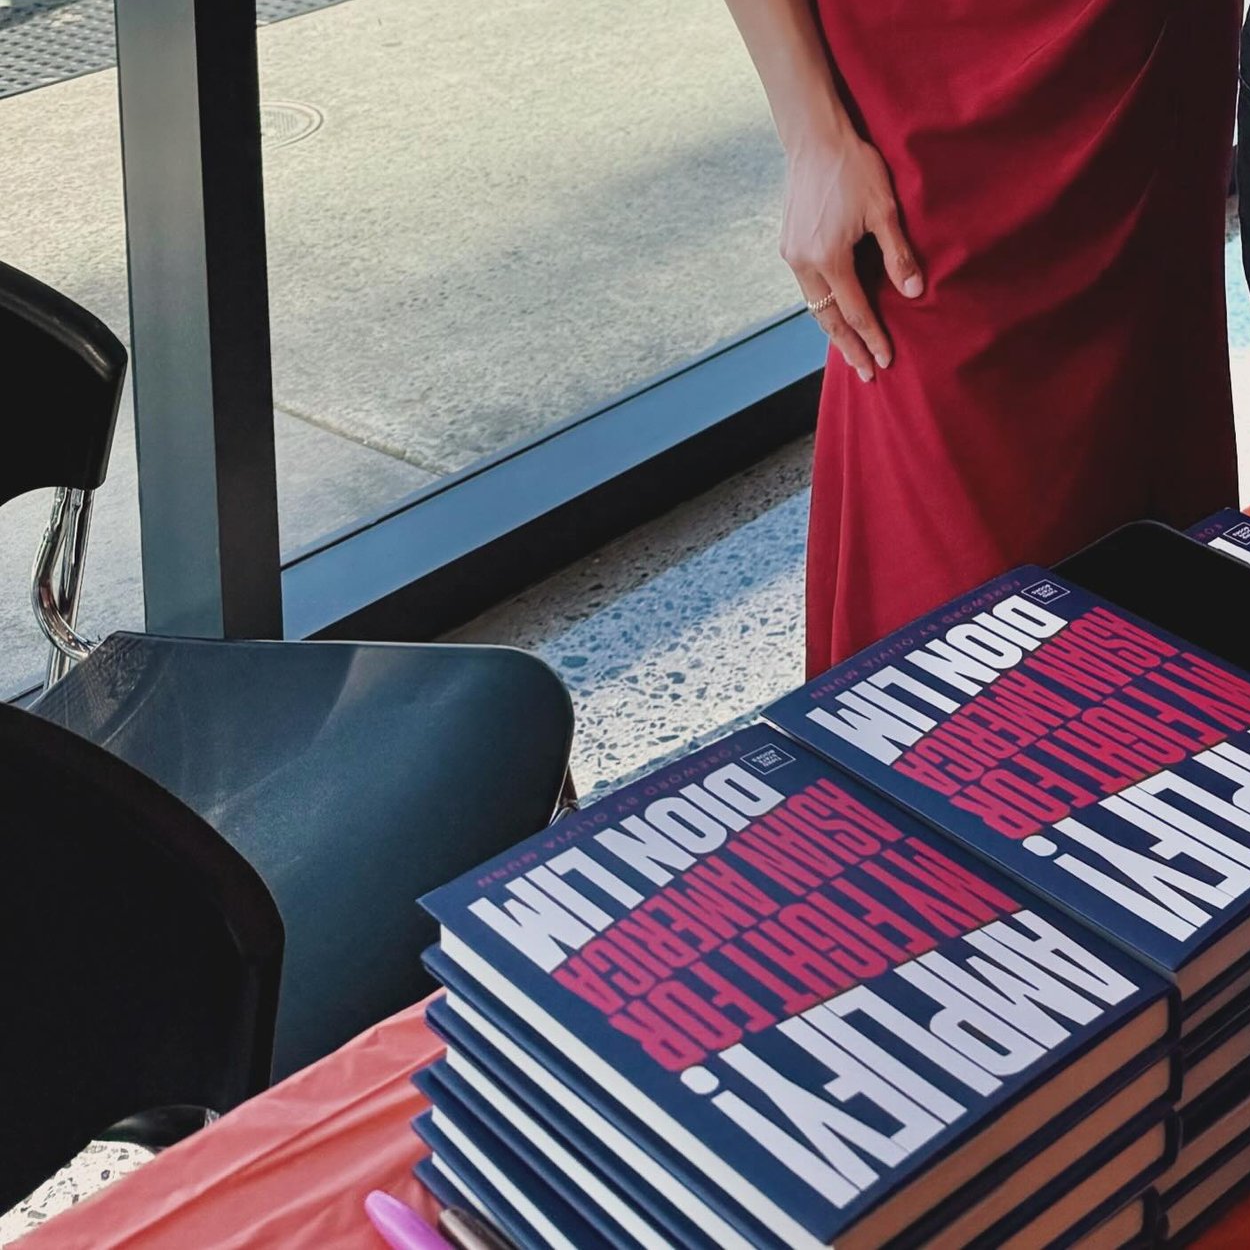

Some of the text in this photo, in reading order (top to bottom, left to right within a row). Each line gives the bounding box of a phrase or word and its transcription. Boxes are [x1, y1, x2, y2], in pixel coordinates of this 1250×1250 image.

[805, 594, 1068, 766] DION LIM
[892, 606, 1178, 796] ASIAN AMERICA
[1038, 686, 1227, 795] FIGHT
[467, 762, 787, 973] DION LIM
[949, 753, 1098, 840] FOR
[550, 778, 904, 1017] ASIAN AMERICA
[608, 837, 1022, 1071] MY FIGHT FOR
[680, 909, 1139, 1209] AMPLIFY!
